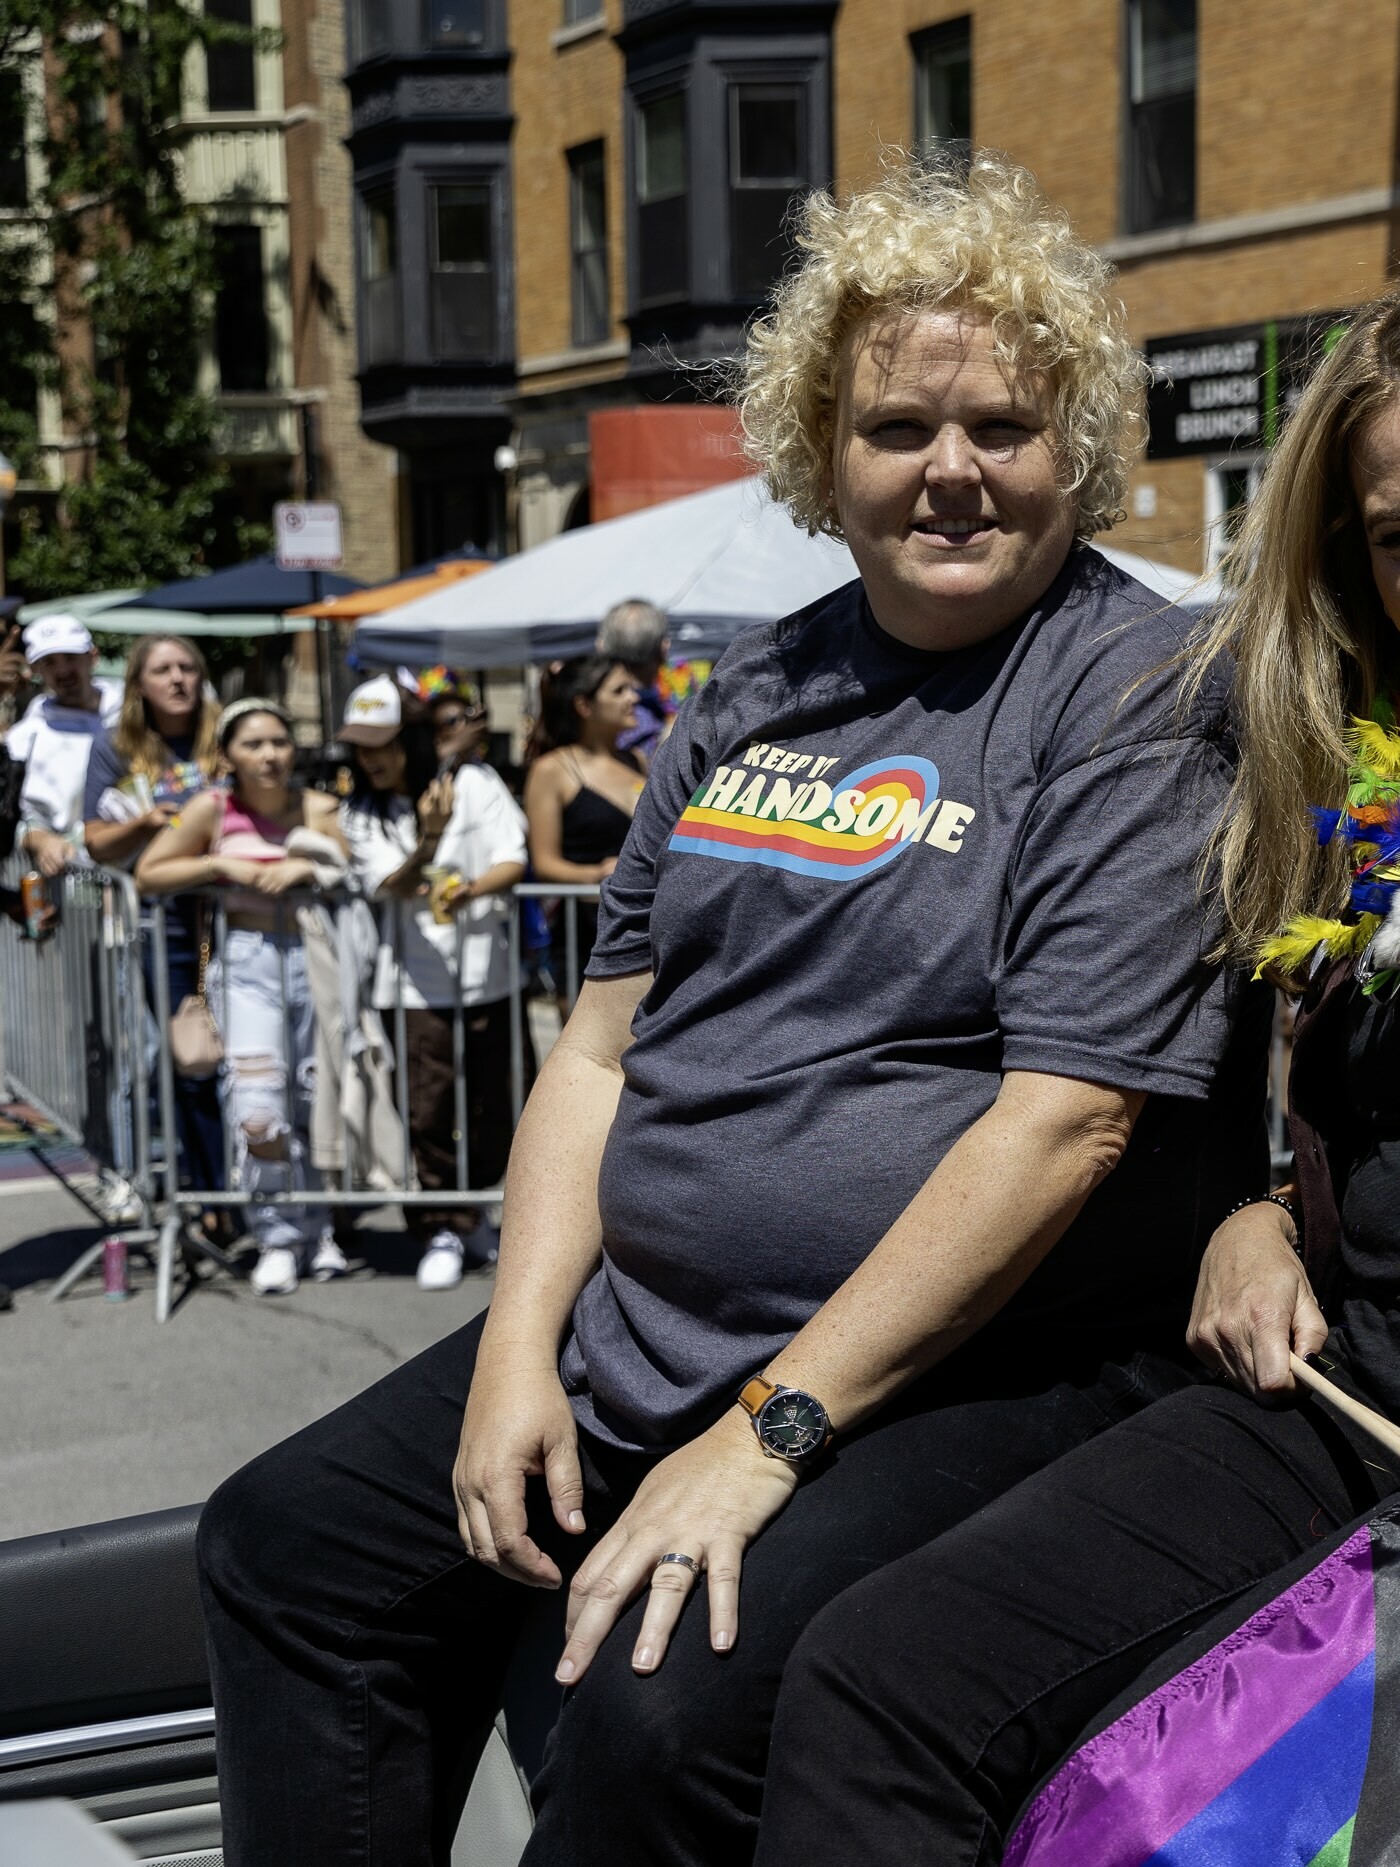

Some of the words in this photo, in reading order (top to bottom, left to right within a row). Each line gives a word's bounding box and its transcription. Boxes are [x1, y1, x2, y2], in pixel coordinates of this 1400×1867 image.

[1151, 341, 1258, 382] BREAKFAST
[1190, 374, 1259, 410] LUNCH
[1176, 406, 1259, 443] BRUNCH
[742, 743, 810, 774] KEEP
[806, 755, 841, 779] IT
[698, 766, 976, 853] HANDSOME
